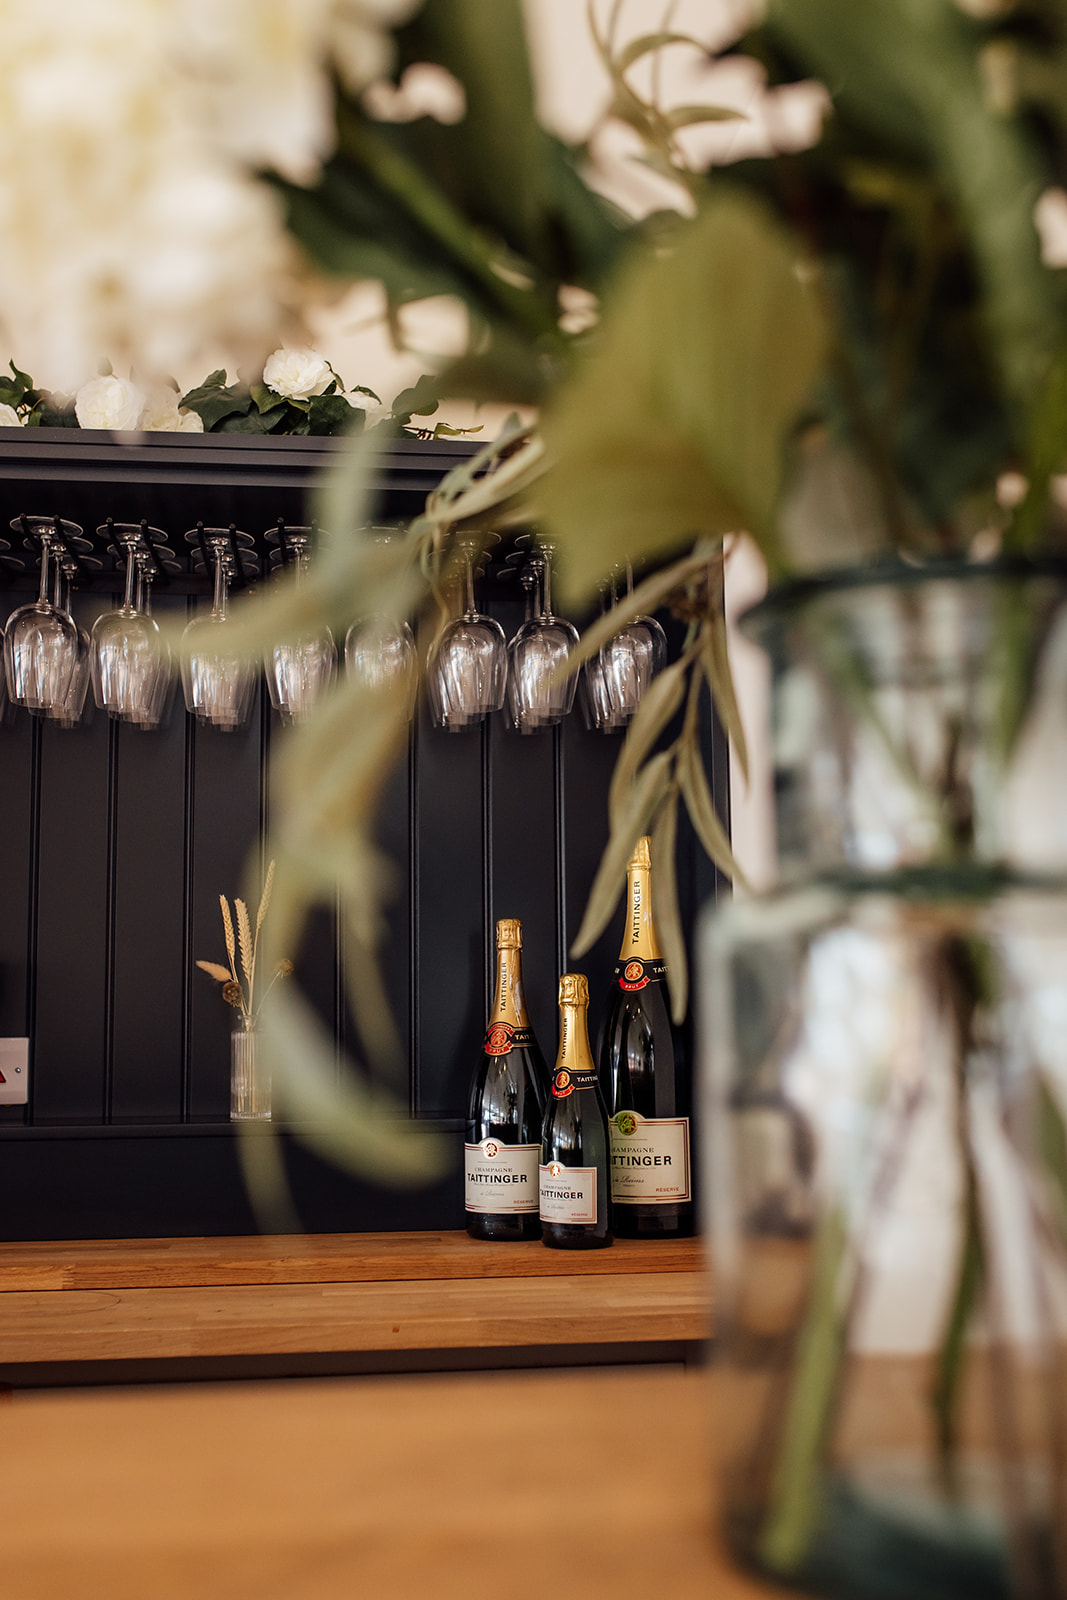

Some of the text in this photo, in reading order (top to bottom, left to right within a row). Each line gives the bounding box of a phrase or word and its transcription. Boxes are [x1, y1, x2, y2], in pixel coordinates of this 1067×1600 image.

[632, 881, 641, 945] TAITTINGER
[500, 962, 508, 1012] TAITTINGER
[467, 1173, 528, 1183] TAITTINGER
